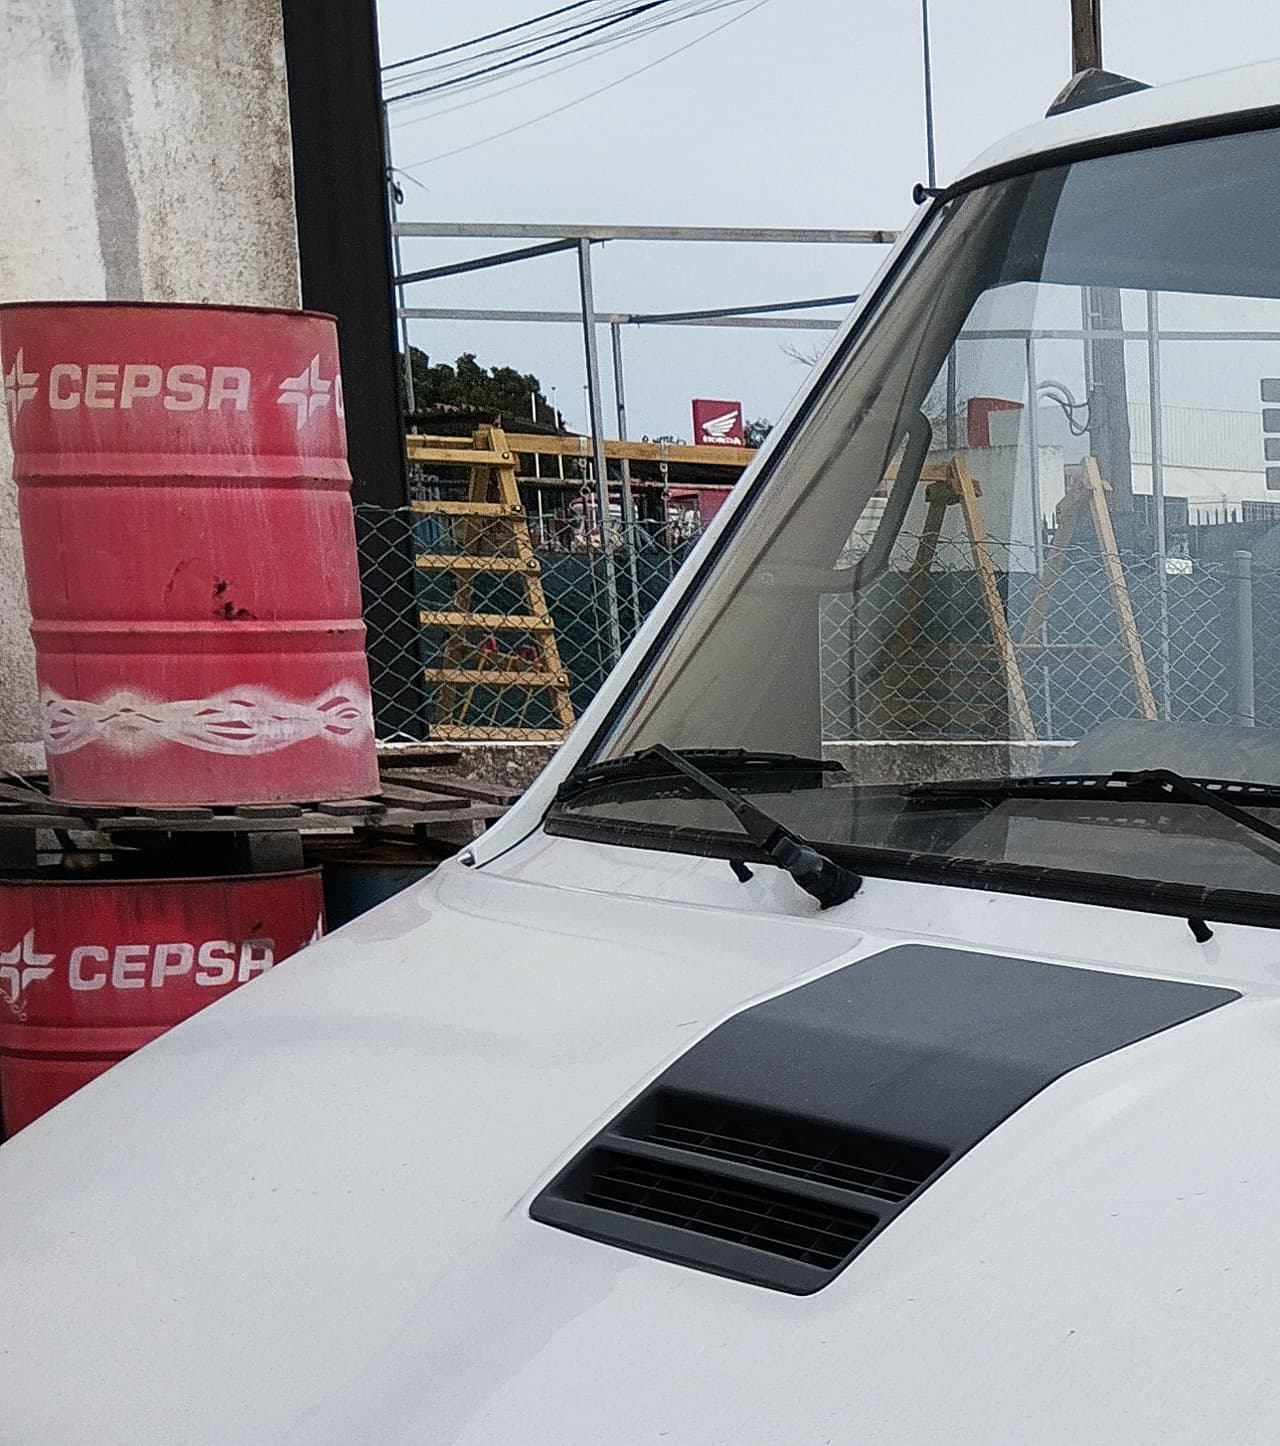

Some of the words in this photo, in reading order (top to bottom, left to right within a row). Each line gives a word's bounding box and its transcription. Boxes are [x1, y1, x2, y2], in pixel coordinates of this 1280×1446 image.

[49, 363, 251, 412] CEPSA
[702, 434, 742, 446] HONDA
[68, 938, 275, 991] CEPSA
